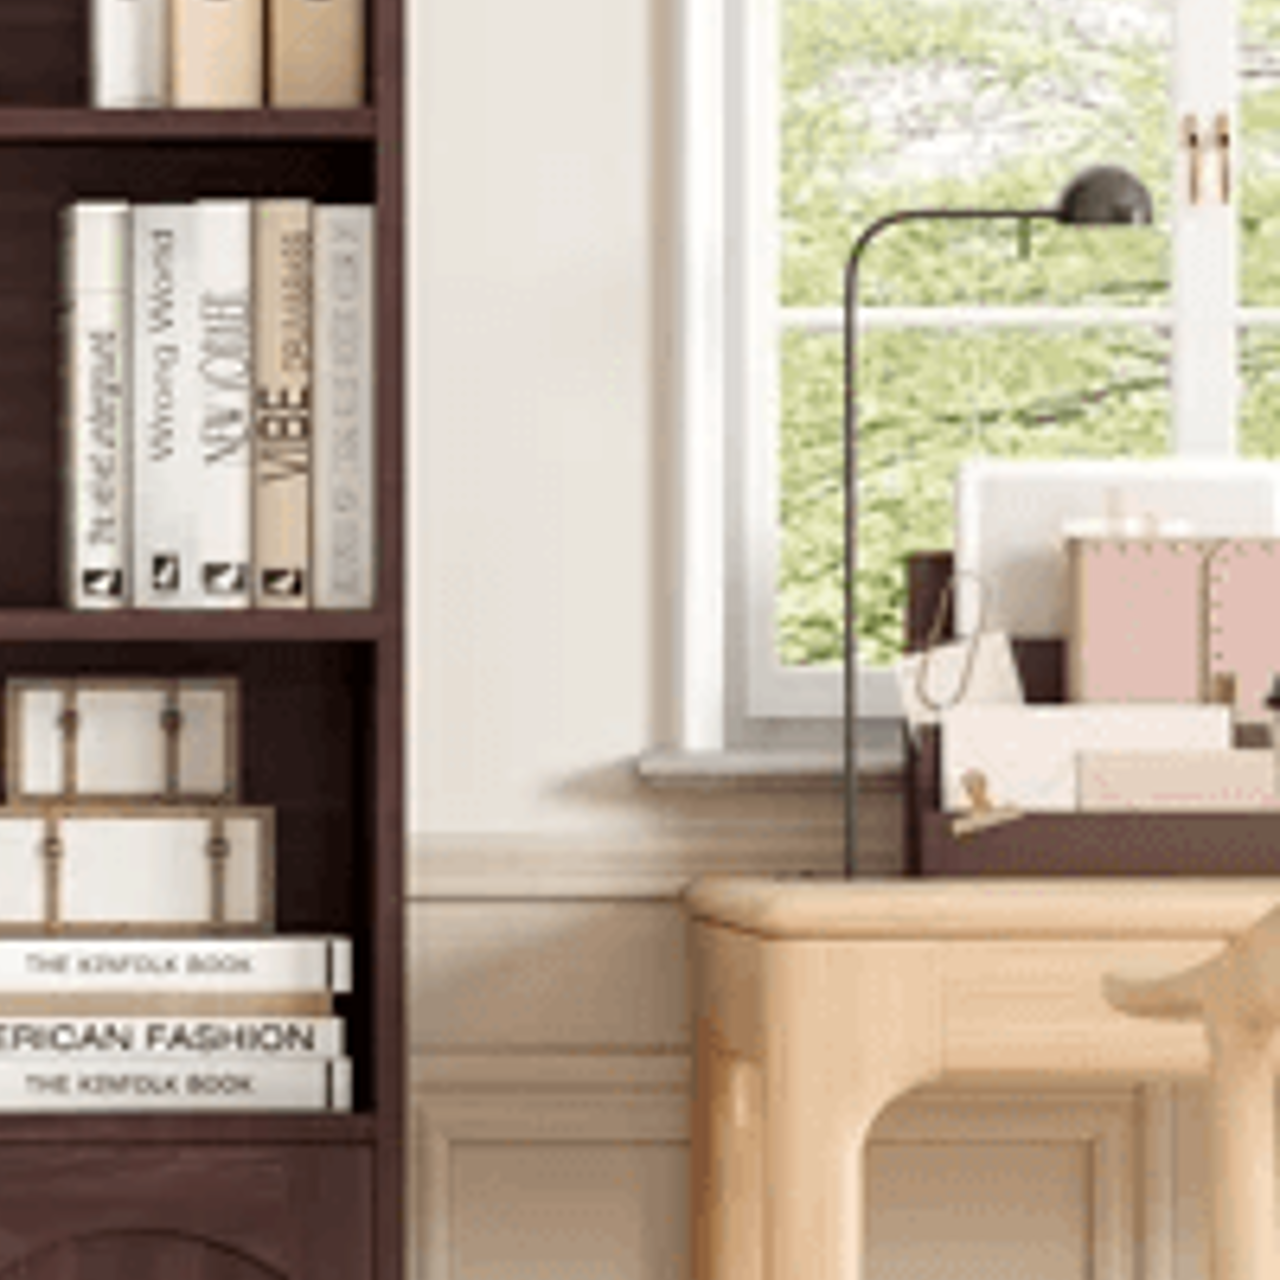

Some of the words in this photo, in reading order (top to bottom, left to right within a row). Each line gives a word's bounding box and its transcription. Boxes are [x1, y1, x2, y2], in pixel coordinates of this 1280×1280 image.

[151, 344, 180, 462] Wrong
[256, 386, 310, 484] VIBE
[25, 953, 67, 975] THE
[144, 1023, 316, 1053] FASHION
[25, 1074, 67, 1096] THE
[185, 1074, 255, 1096] BOOK
